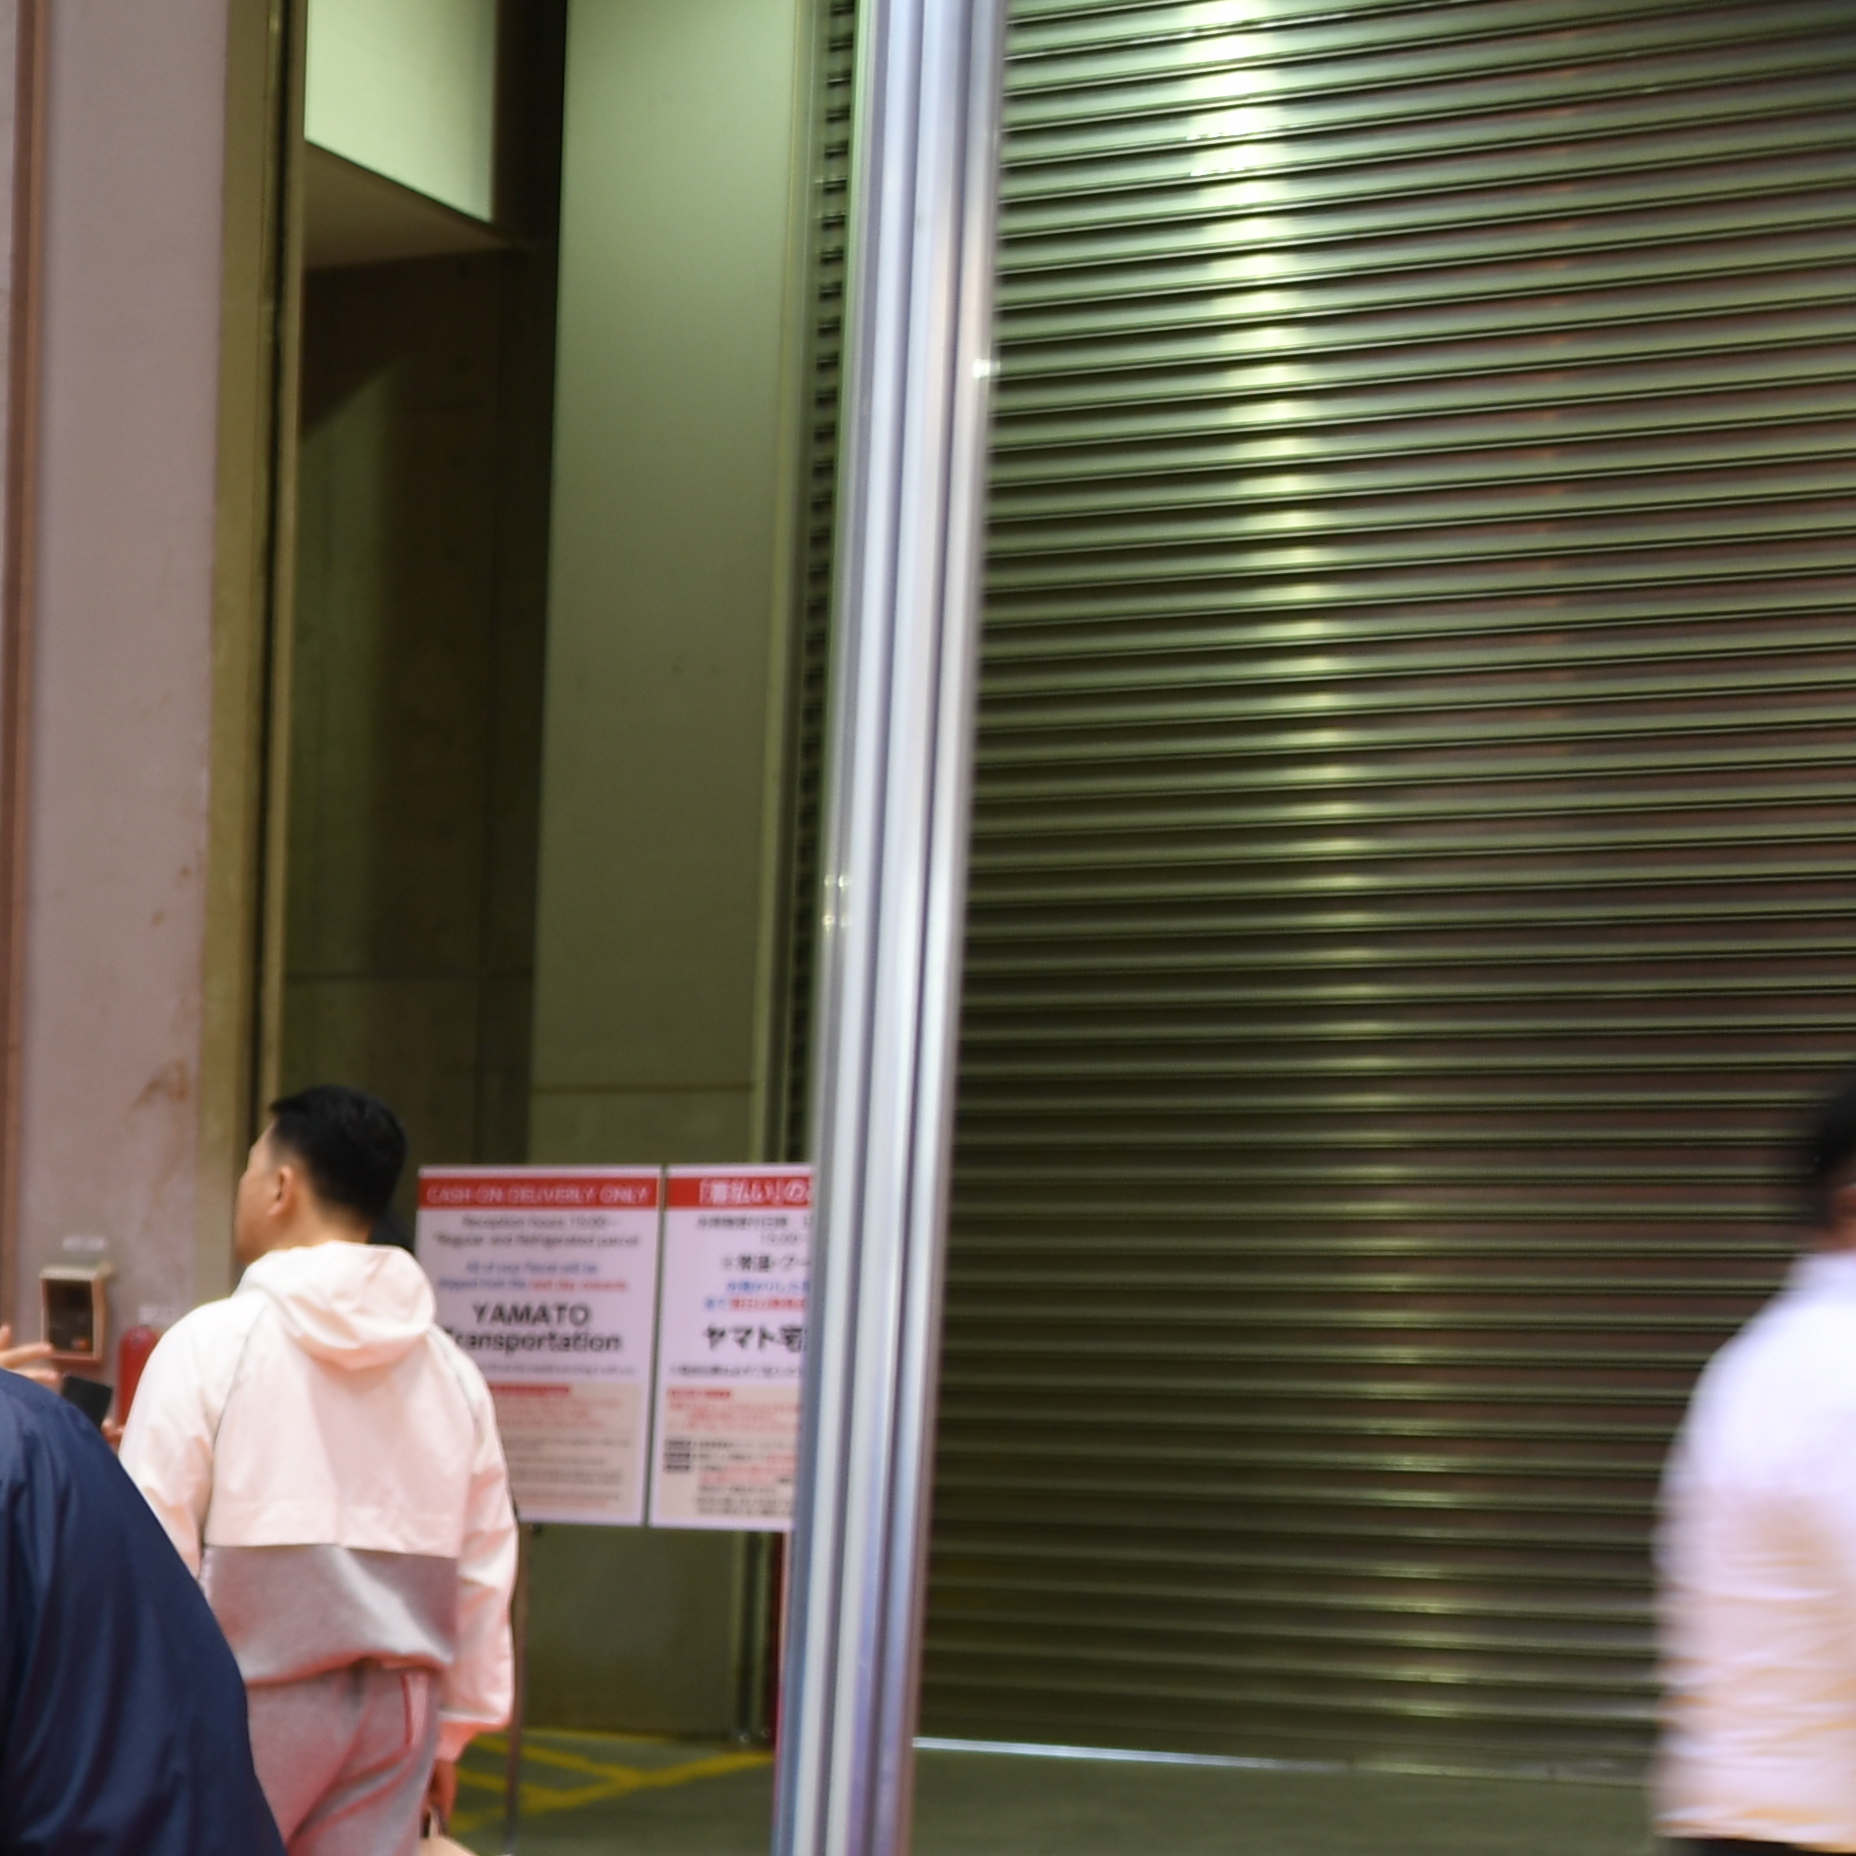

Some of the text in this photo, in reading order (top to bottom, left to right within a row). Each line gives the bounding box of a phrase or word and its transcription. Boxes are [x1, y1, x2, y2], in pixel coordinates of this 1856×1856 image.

[427, 1184, 648, 1203] CASH ON DELIVERY ONLY
[472, 1304, 591, 1326] YAMATO
[444, 1326, 623, 1355] ransportation
